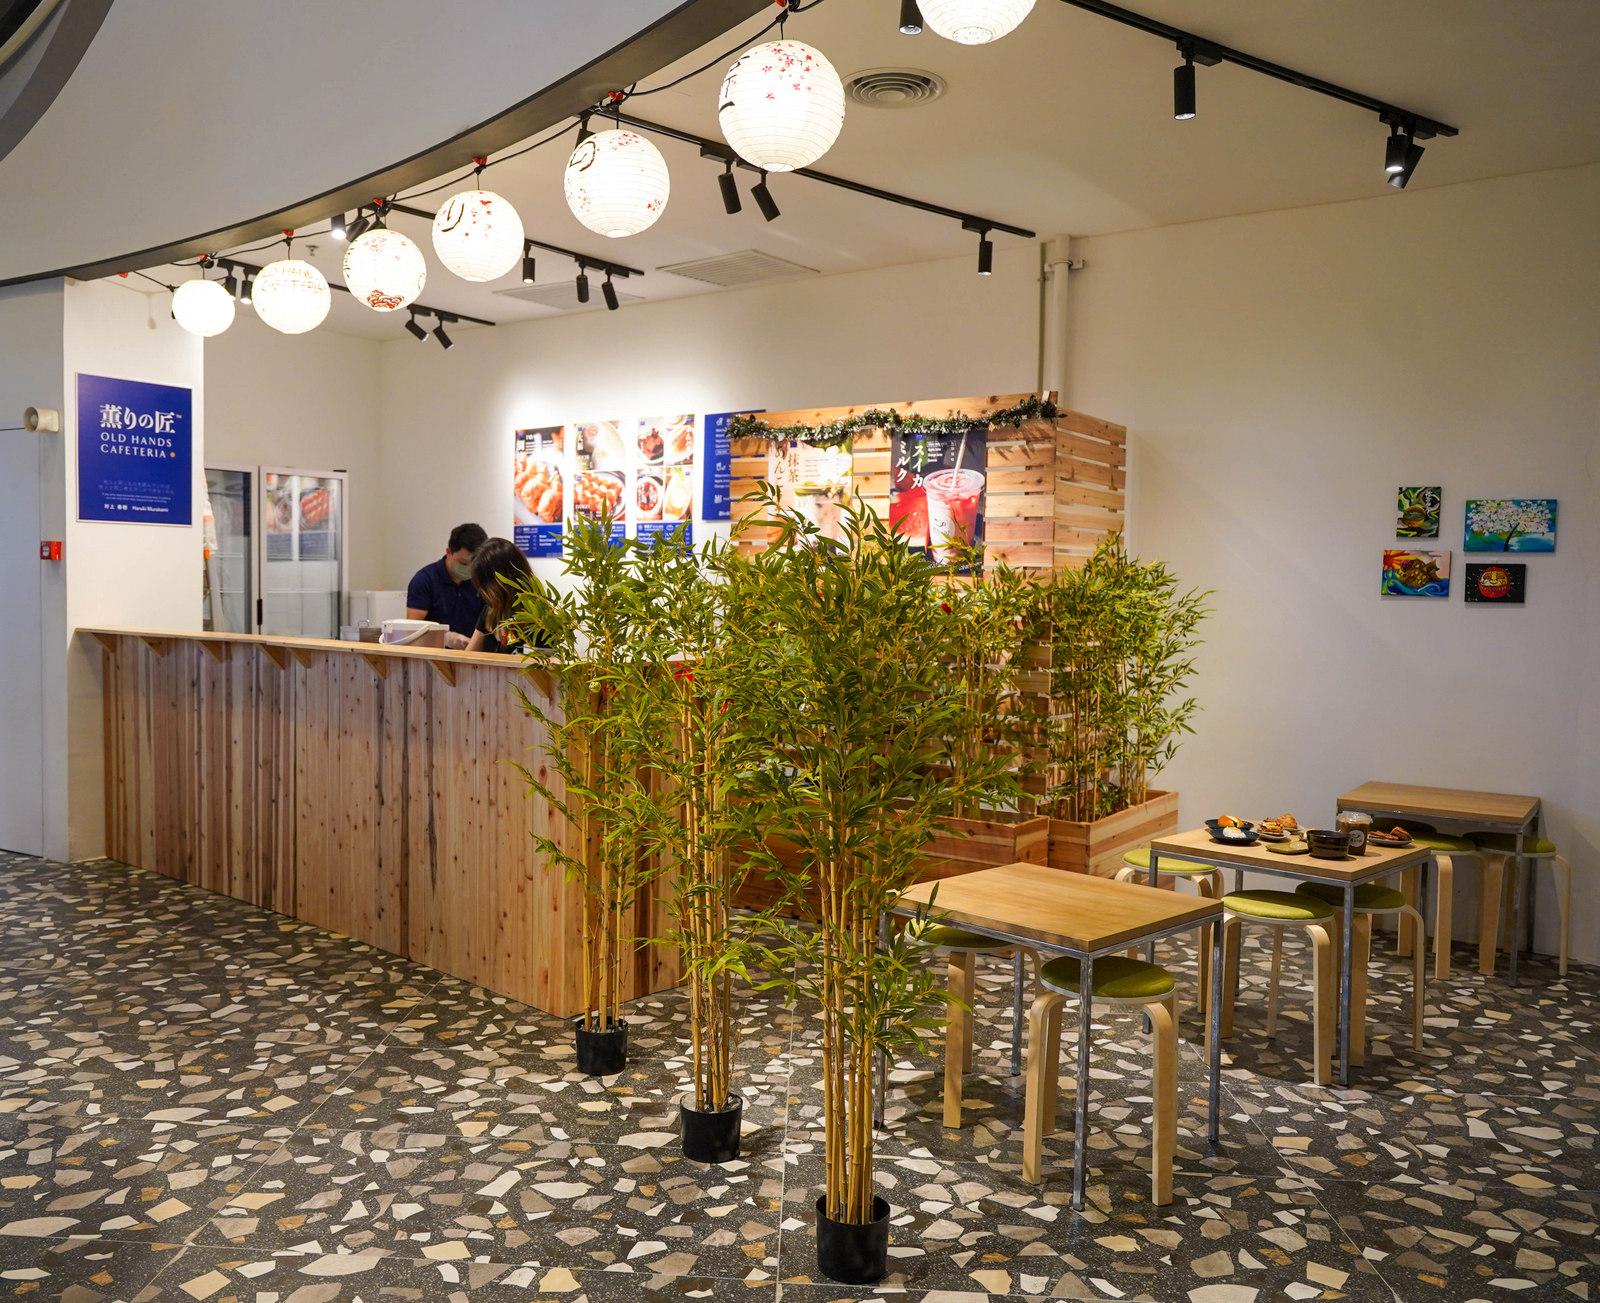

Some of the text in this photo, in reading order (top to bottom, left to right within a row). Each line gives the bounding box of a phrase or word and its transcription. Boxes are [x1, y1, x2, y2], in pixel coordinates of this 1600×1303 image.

[101, 432, 172, 447] OLD HANDS
[101, 444, 166, 458] CAFETERIA
[895, 440, 911, 483] ミルク
[912, 444, 924, 489] スイカ
